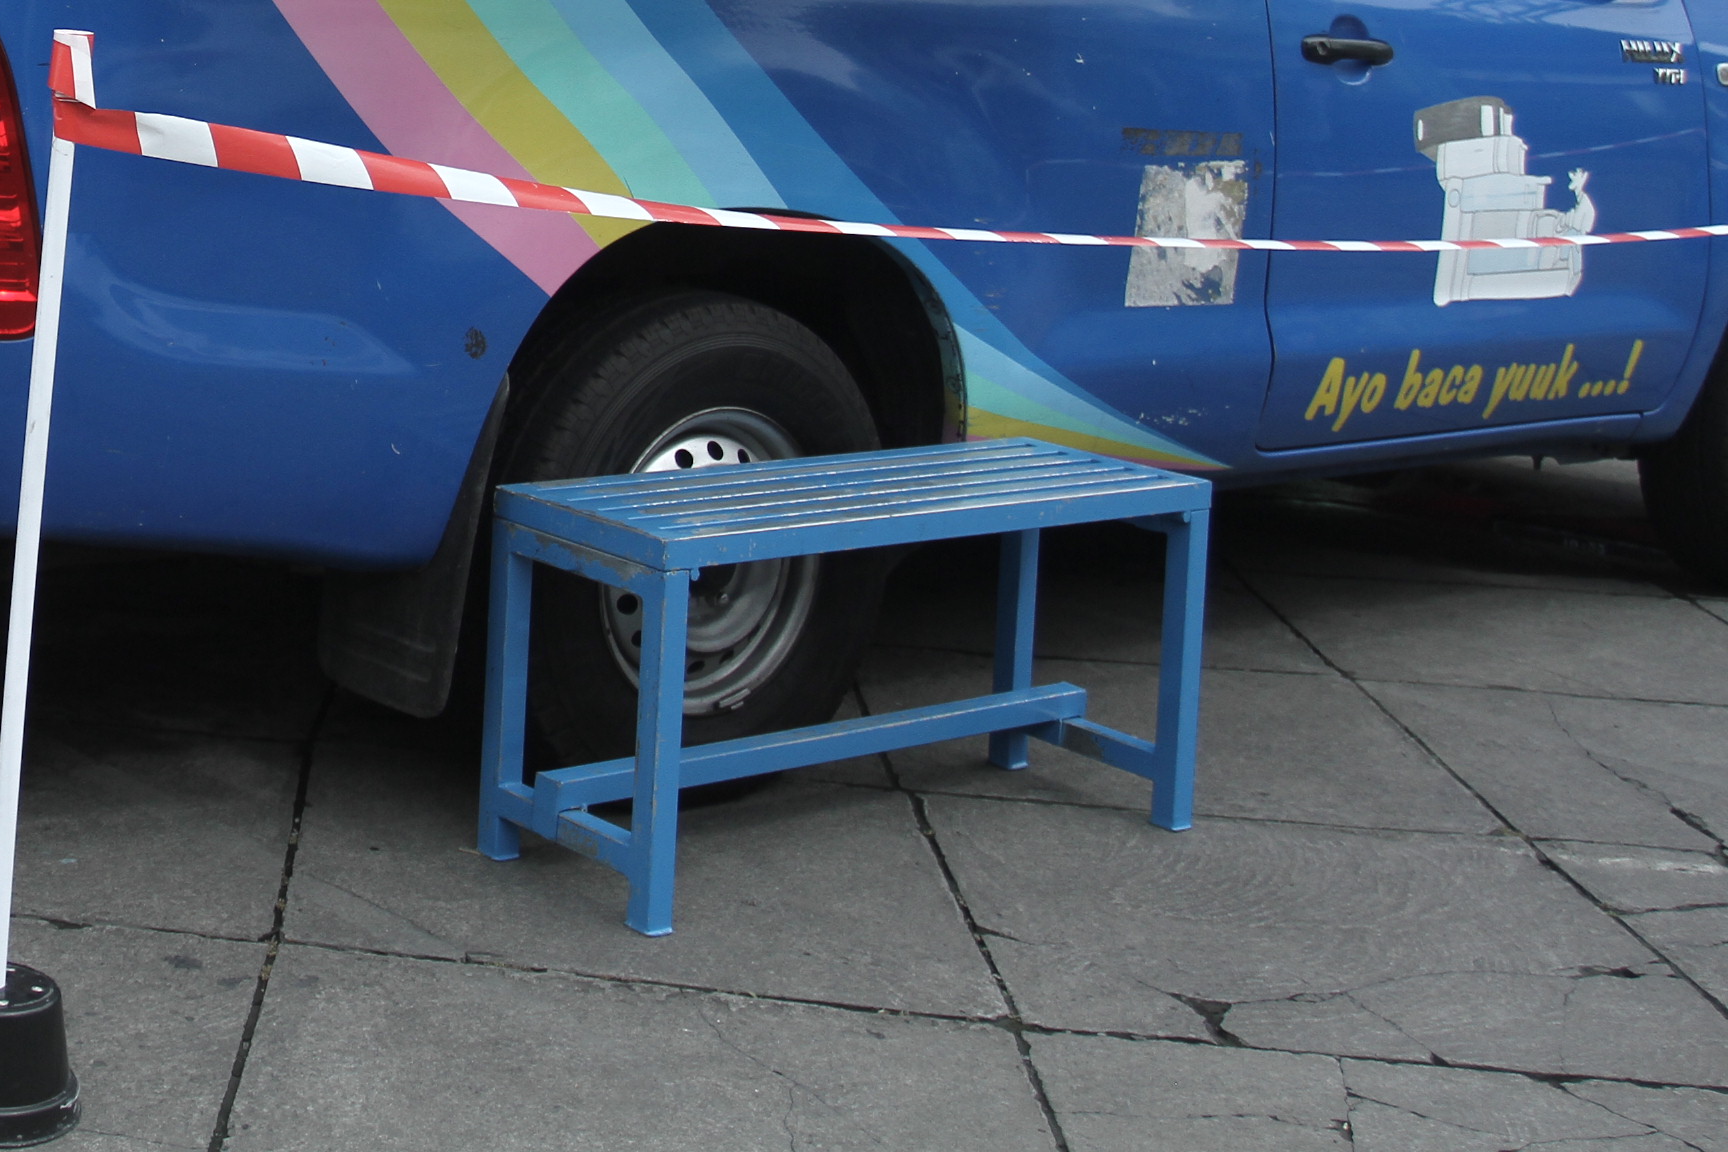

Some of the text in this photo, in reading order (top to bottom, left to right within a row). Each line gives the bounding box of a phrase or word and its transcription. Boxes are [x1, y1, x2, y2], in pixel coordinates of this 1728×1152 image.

[1304, 356, 1387, 432] Ayo
[1394, 349, 1484, 411] baca
[1482, 343, 1579, 420] yuuk
